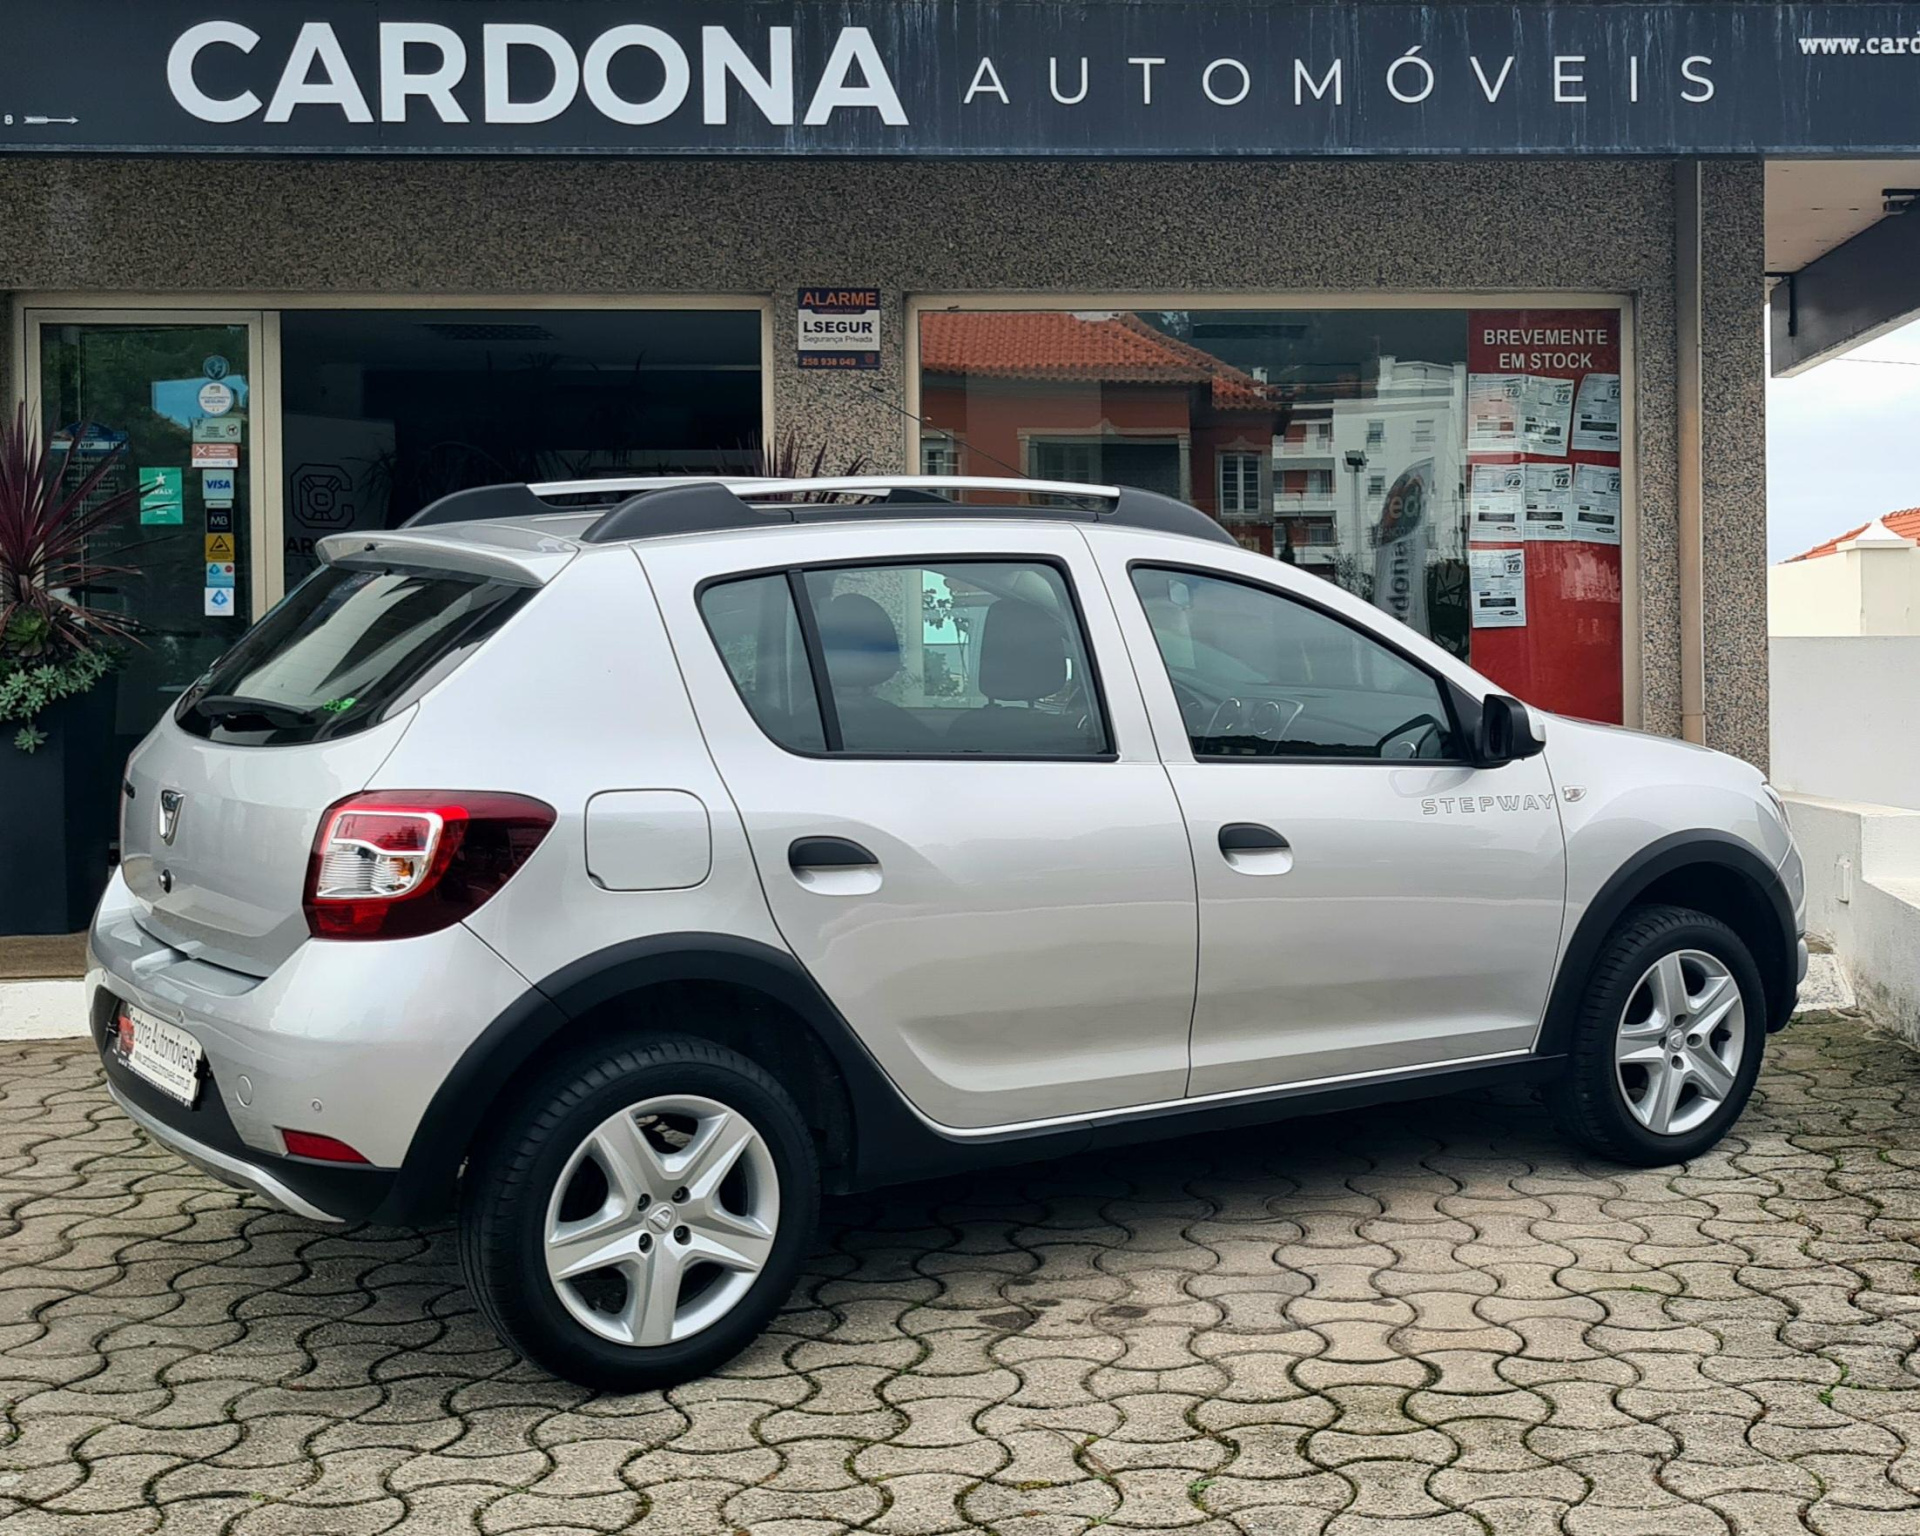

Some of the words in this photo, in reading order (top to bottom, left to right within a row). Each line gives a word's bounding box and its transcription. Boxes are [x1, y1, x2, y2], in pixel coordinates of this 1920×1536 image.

[166, 20, 909, 126] CARDONA
[964, 45, 1715, 105] AUTOMÓVEIS
[802, 292, 877, 306] ALARME
[803, 321, 873, 333] LSEGUR
[803, 335, 843, 344] Segurança
[845, 335, 873, 343] Privada
[1483, 329, 1608, 345] BREVEMENTE
[1499, 353, 1525, 369] EM
[1530, 353, 1593, 369] STOCK
[206, 480, 231, 489] VISA
[210, 516, 228, 525] MB
[1421, 794, 1555, 815] STEPWAY
